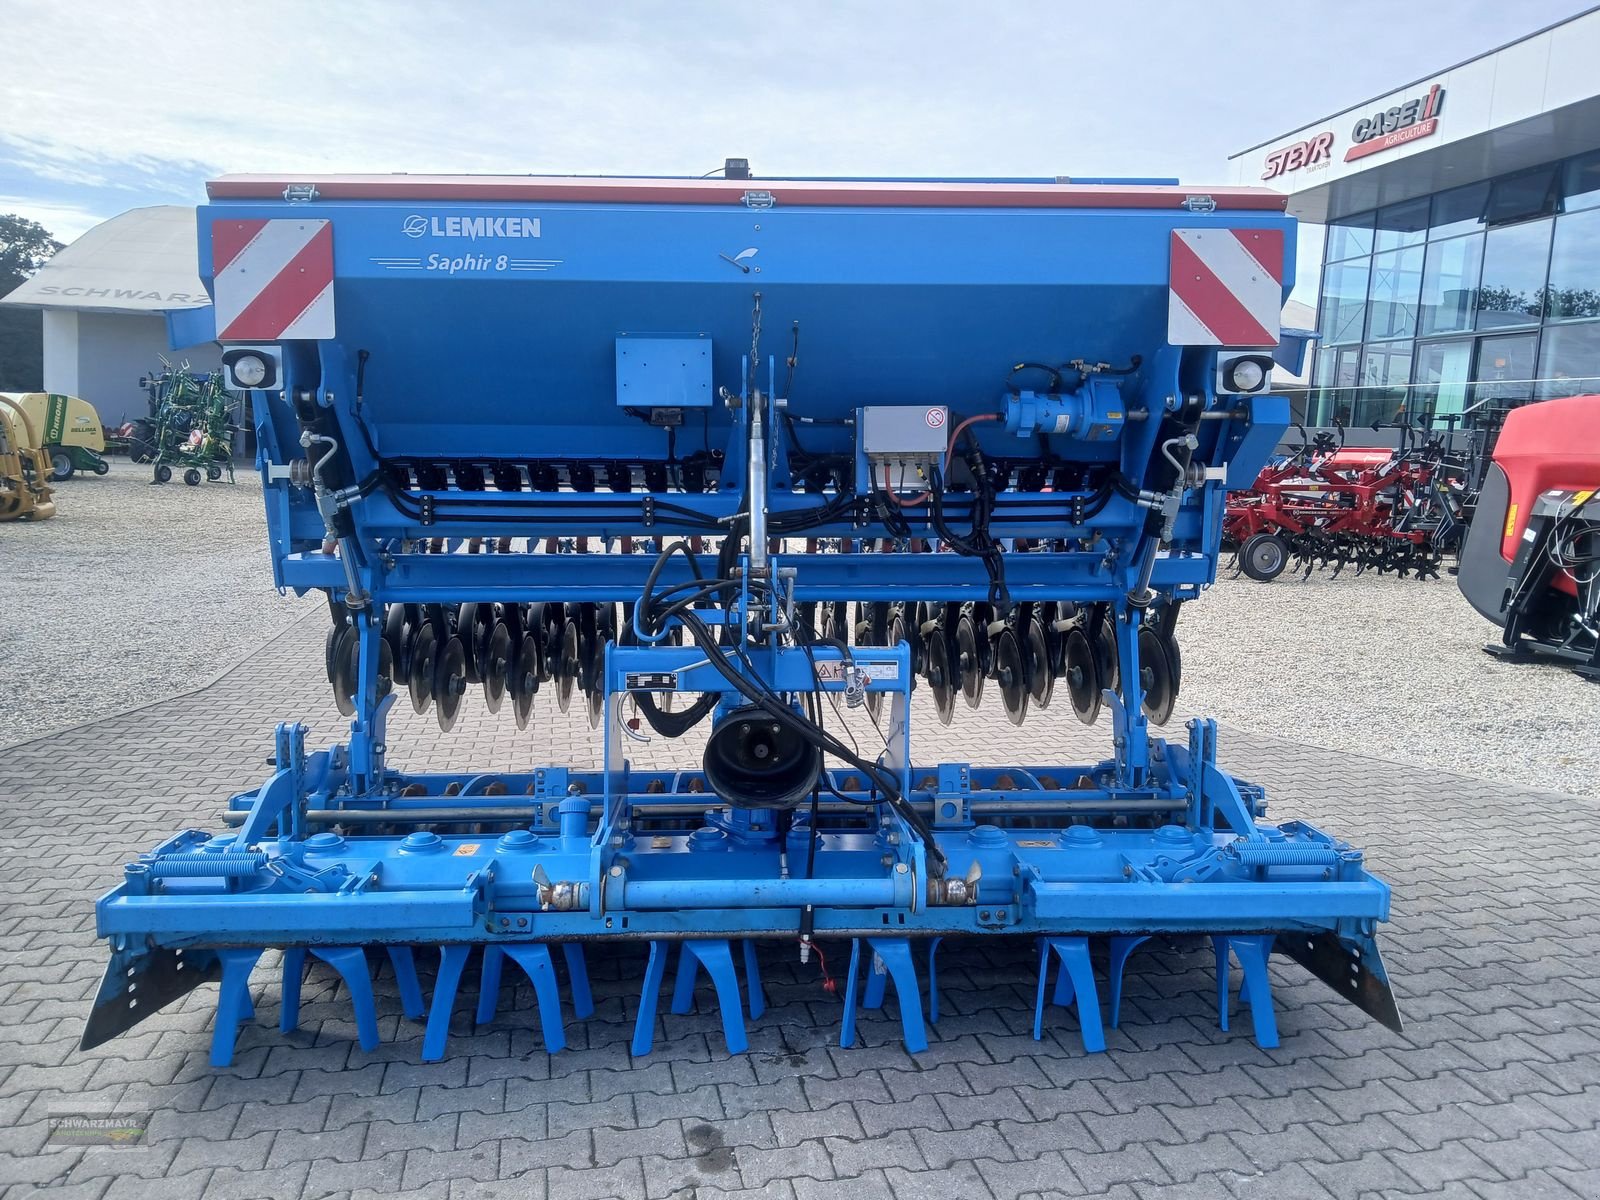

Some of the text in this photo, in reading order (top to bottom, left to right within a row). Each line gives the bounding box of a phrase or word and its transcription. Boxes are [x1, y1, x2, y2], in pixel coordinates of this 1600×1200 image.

[1352, 98, 1421, 143] CASE
[1384, 122, 1431, 146] AGRICULTURE
[1261, 132, 1334, 180] STEYR
[431, 216, 541, 242] LEMKEN
[426, 253, 508, 275] Saphir 8
[53, 397, 63, 429] KRONE
